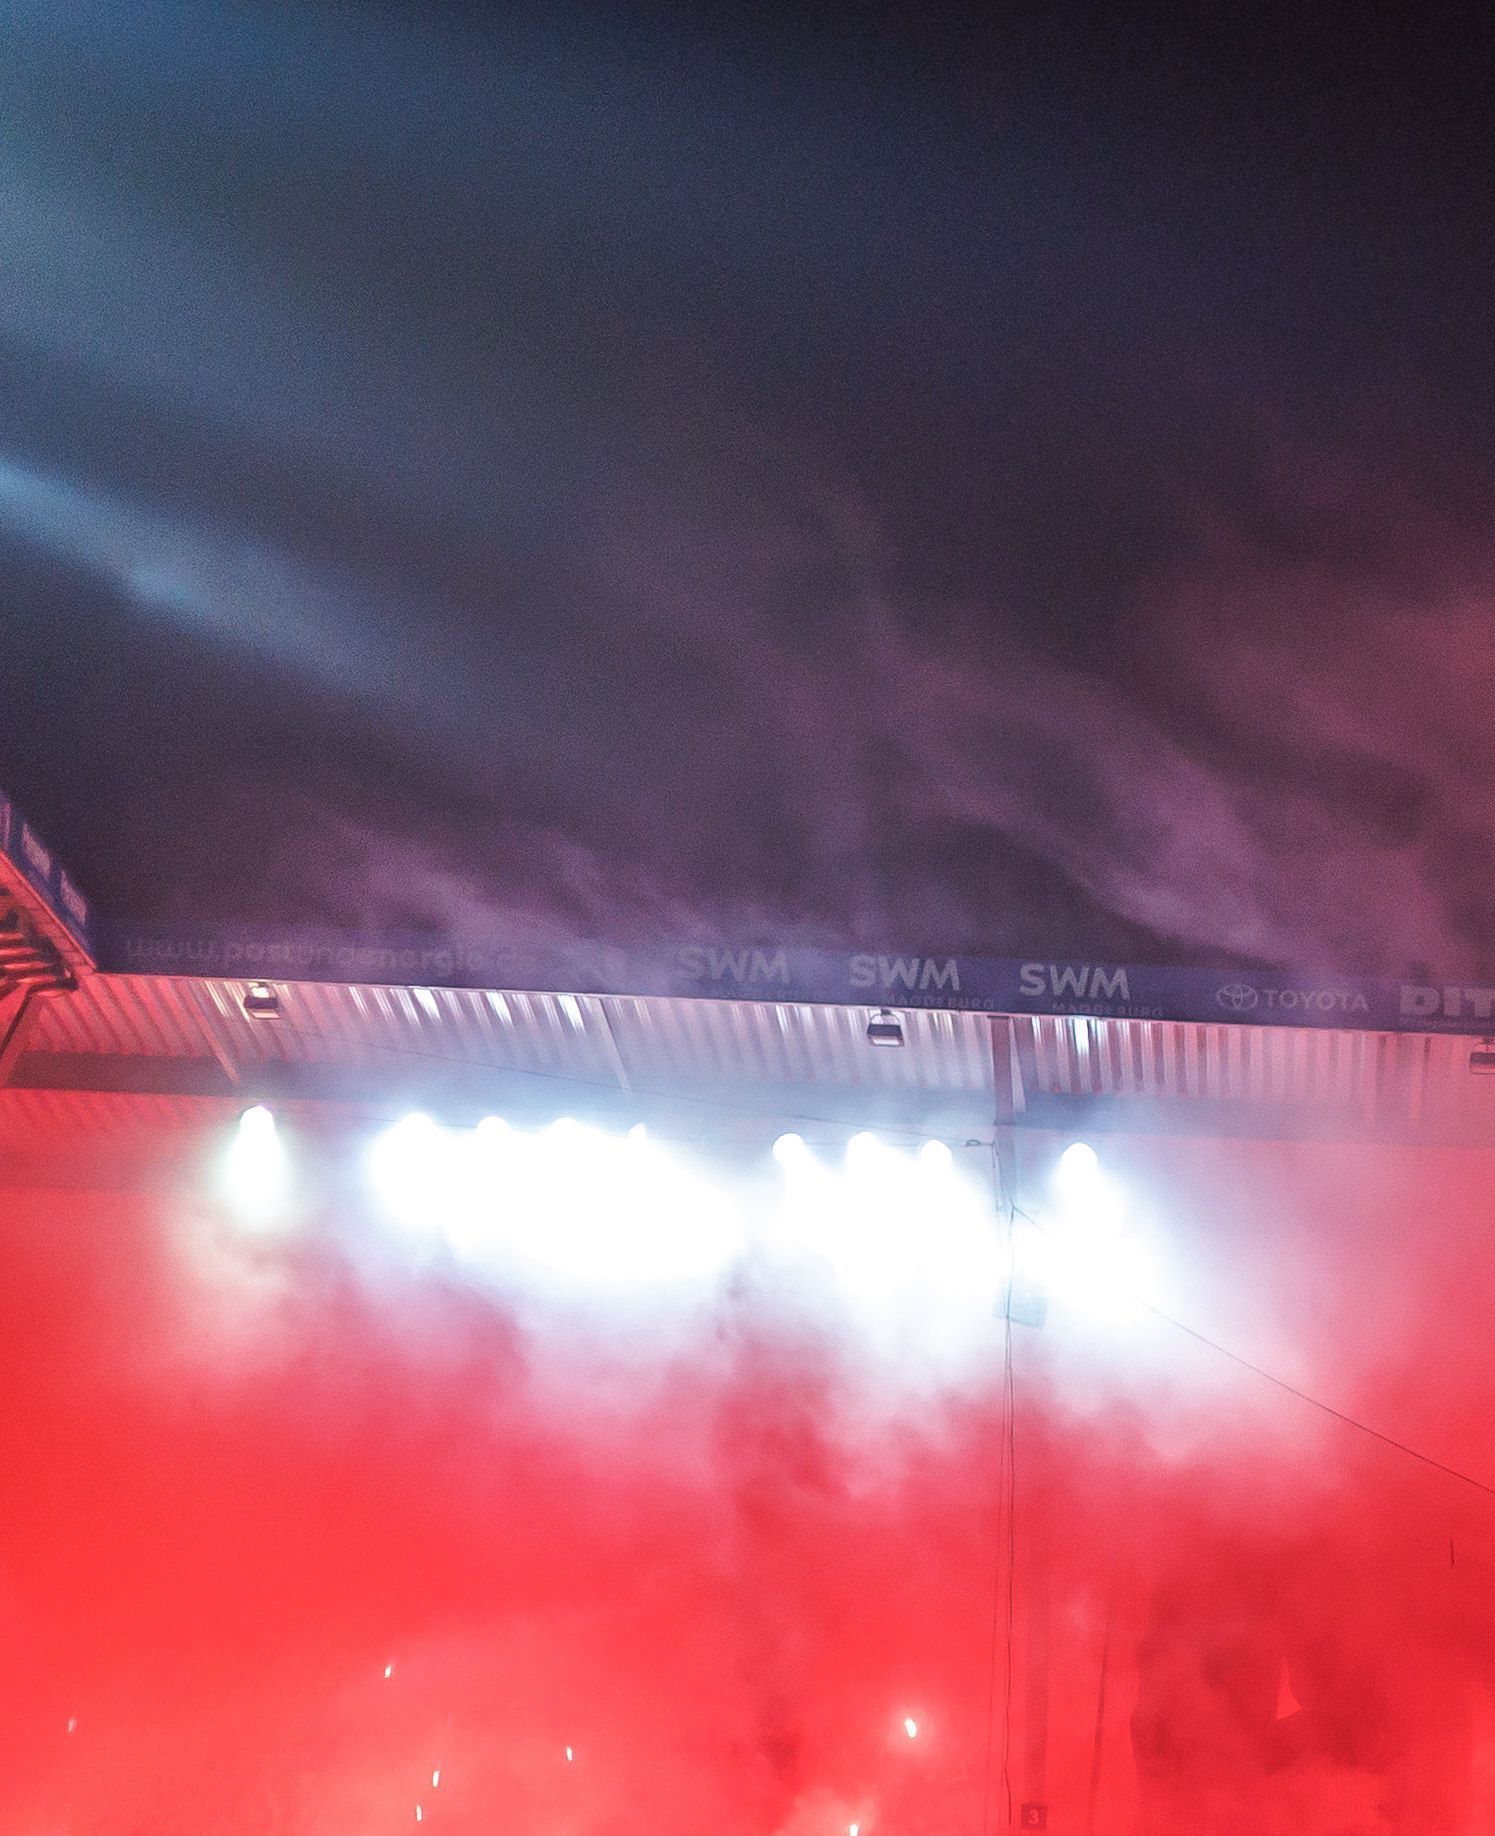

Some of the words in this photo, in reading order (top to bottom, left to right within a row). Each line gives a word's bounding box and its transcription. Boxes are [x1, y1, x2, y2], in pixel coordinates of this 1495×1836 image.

[677, 943, 791, 984] SWM
[849, 952, 961, 991] SWM
[1018, 962, 1130, 1000] SWM
[1262, 987, 1370, 1014] TOYOTA
